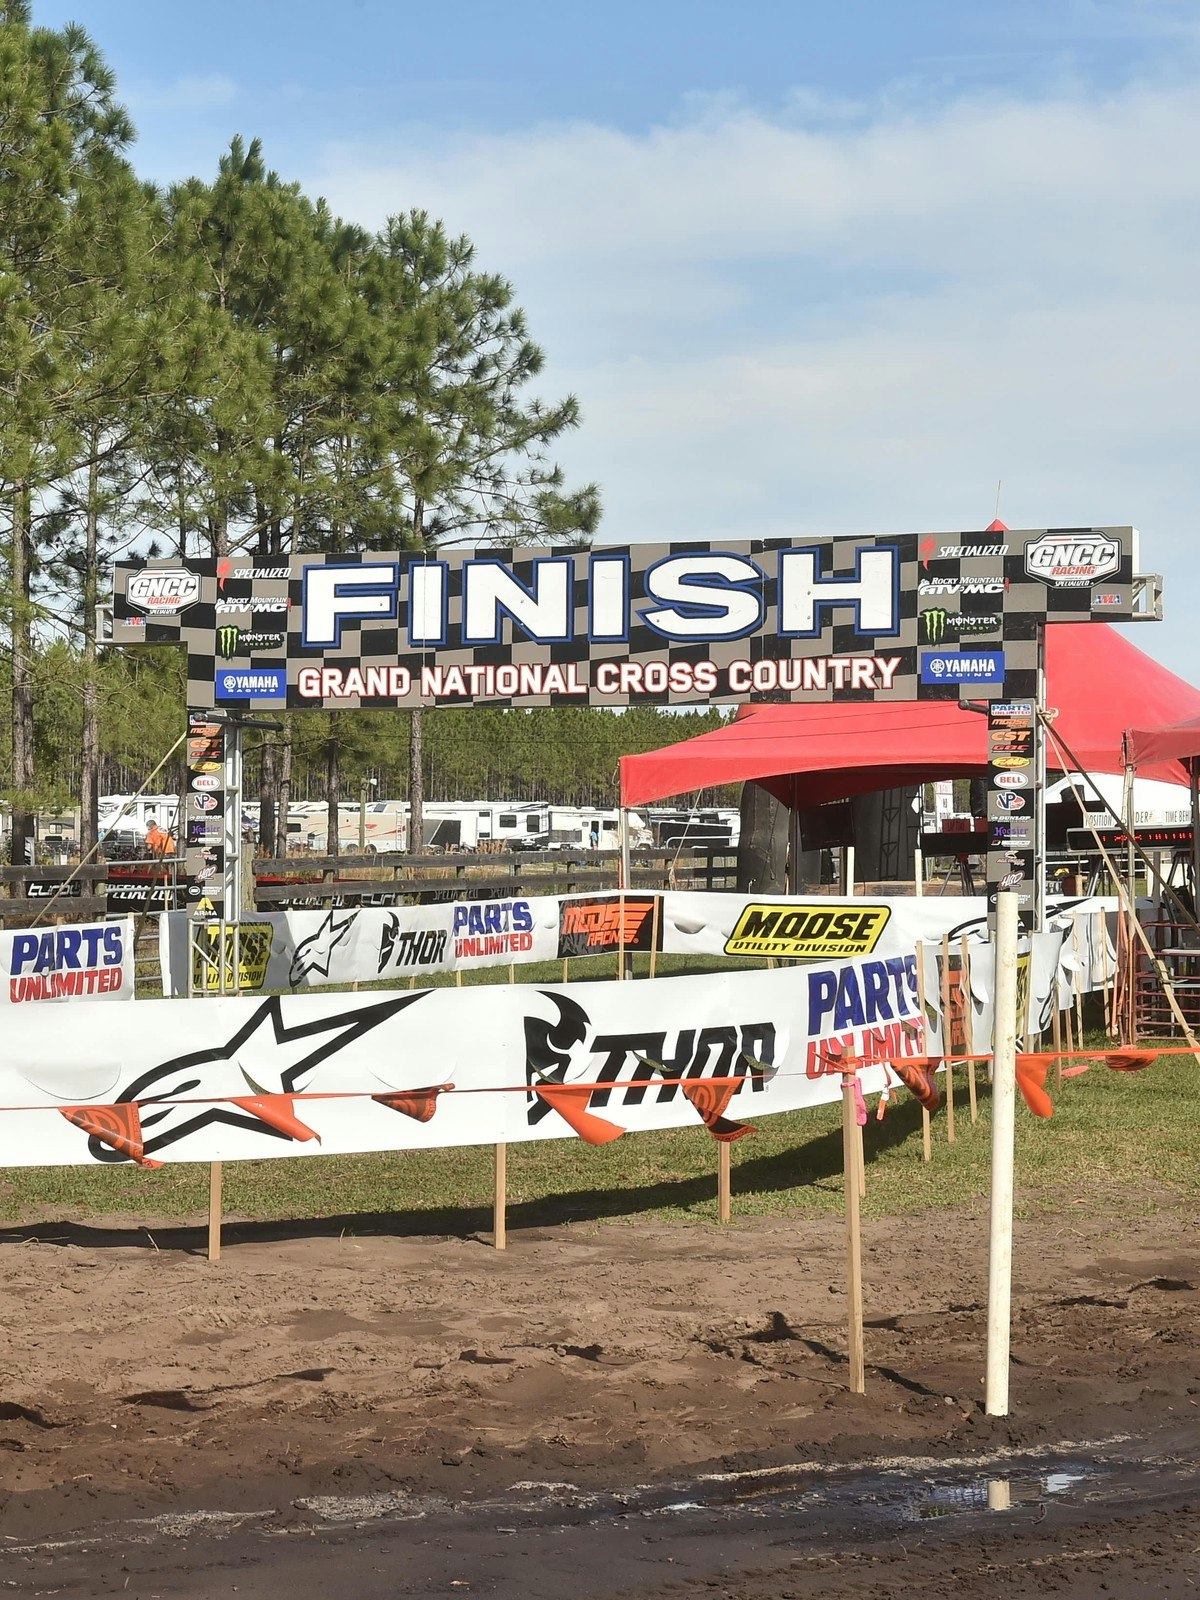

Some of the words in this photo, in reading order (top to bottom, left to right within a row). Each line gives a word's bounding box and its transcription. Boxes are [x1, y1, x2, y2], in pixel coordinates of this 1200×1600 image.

[937, 545, 1009, 557] SPECIALIZED
[1030, 542, 1115, 568] GNCC
[231, 567, 292, 579] SPECIALIZED
[1051, 566, 1097, 575] RACING
[131, 577, 197, 597] GNCC
[147, 596, 182, 605] RACING
[302, 545, 900, 648] FINISH
[947, 616, 997, 626] MONSTER
[238, 632, 280, 642] MONSTER
[945, 658, 996, 672] YAMAHA
[235, 676, 279, 689] YAMAHA
[298, 666, 411, 698] GRAND
[420, 663, 588, 697] NATIONAL
[596, 660, 718, 694] CROSS
[728, 656, 902, 692] COUNTRY
[190, 739, 222, 748] CST
[991, 731, 1031, 741] CST
[1165, 811, 1178, 823] TIME
[994, 826, 1029, 837] Hoosier
[453, 902, 534, 936] PARTS
[562, 903, 654, 934] MOOSE
[741, 910, 881, 941] MOOSE
[10, 927, 123, 975] PARTS
[396, 930, 447, 967] THOR
[454, 931, 533, 958] UNLIMITED
[733, 942, 791, 951] UTILITY
[793, 943, 867, 952] DIVISION
[9, 967, 123, 1004] UNLIMITED
[807, 954, 920, 1036] PARTS
[589, 1022, 777, 1108] THOR
